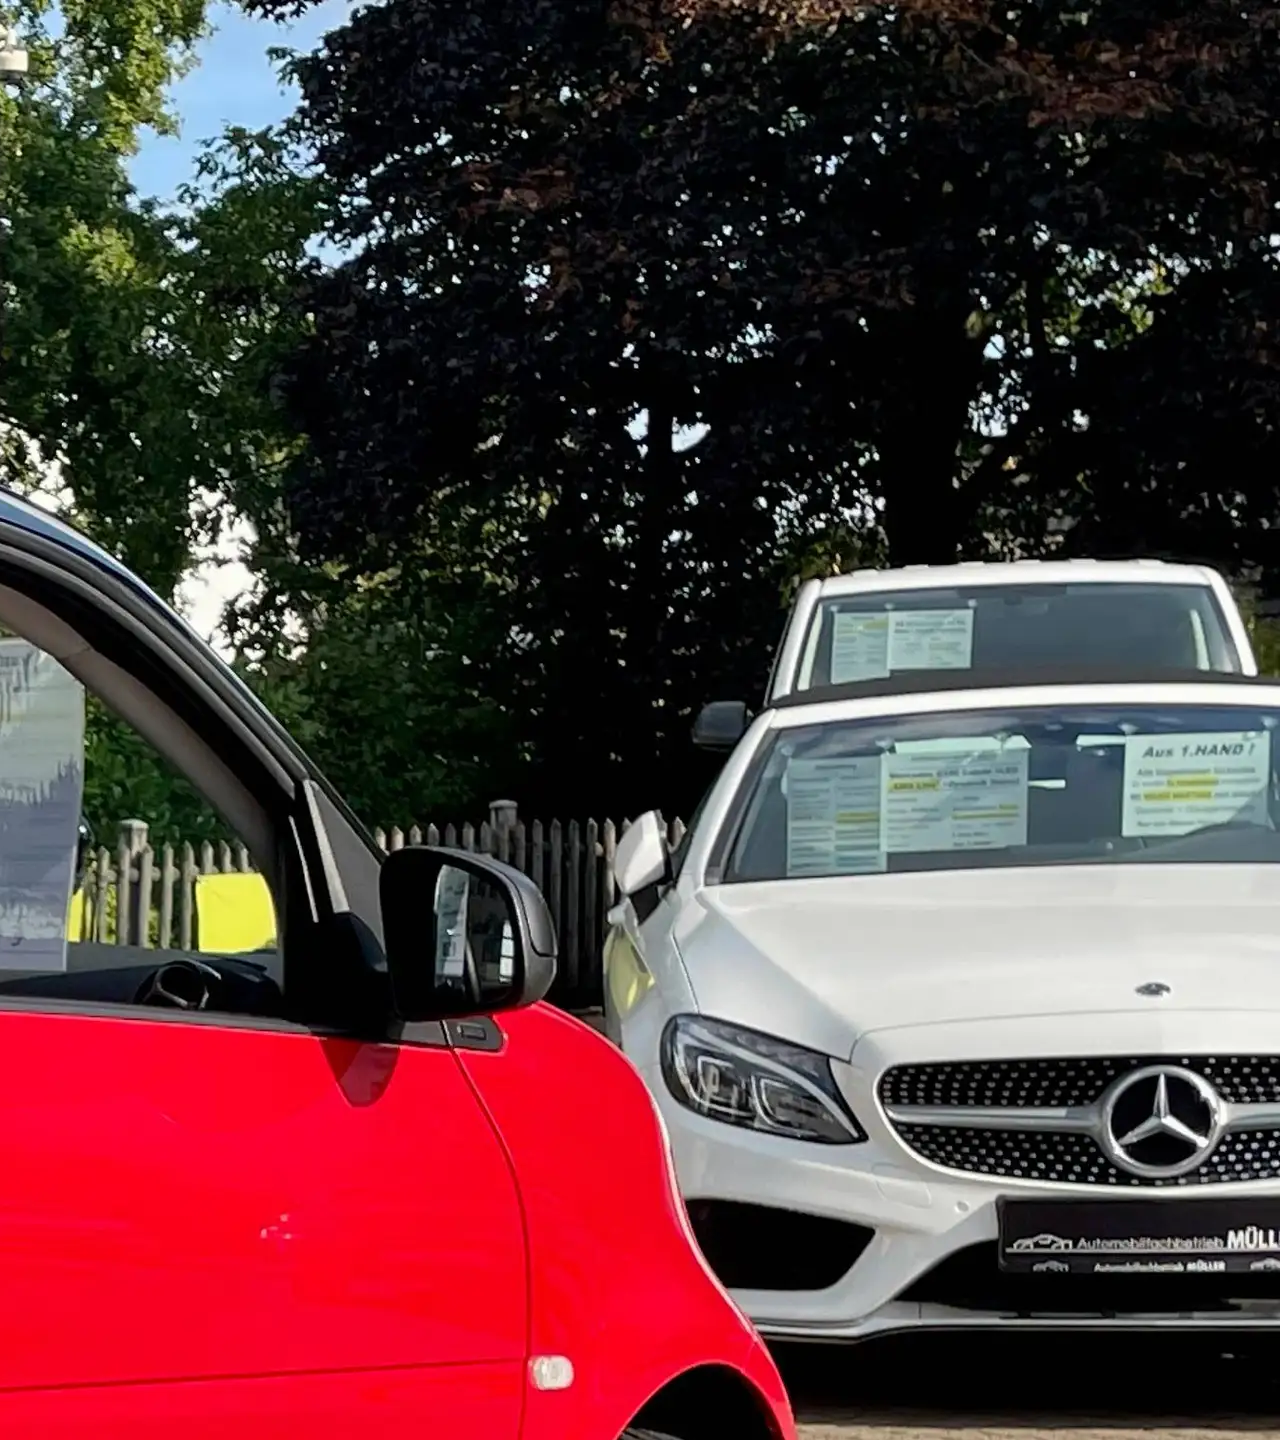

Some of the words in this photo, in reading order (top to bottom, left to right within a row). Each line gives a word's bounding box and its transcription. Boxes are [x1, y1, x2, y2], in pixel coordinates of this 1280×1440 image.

[1142, 745, 1175, 759] Aus
[1182, 743, 1245, 758] 1.HAND
[1227, 1225, 1280, 1250] MÜLL
